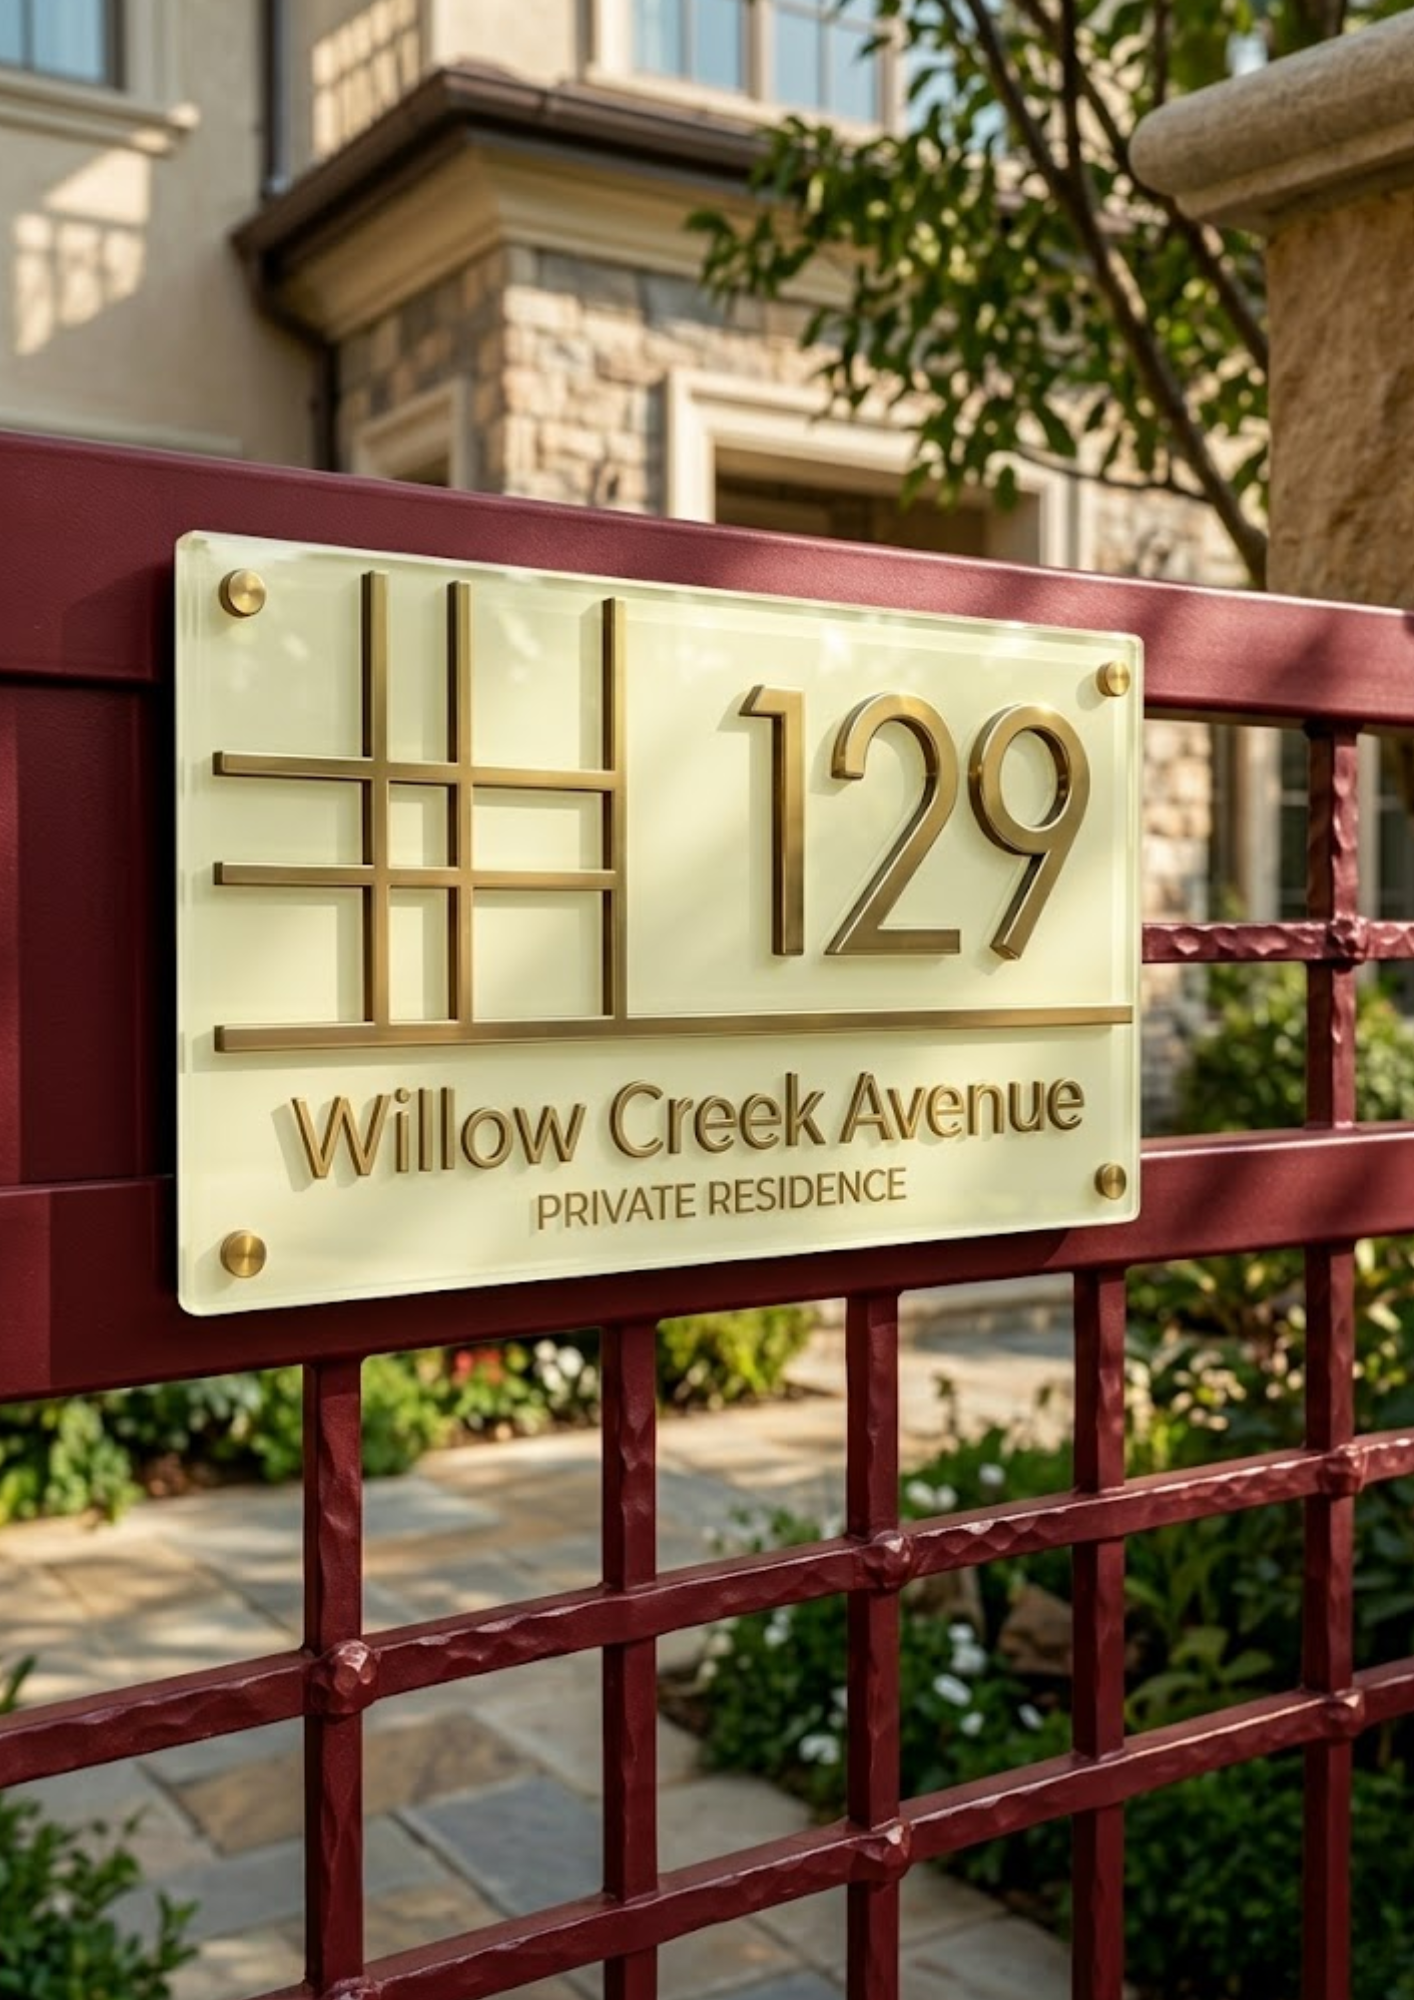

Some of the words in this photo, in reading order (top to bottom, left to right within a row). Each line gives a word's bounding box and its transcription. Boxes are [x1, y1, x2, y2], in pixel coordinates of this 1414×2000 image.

[738, 684, 1091, 961] 129
[290, 1086, 587, 1180] Willow
[608, 1071, 826, 1160] Creek
[838, 1071, 1086, 1145] Avenue
[536, 1182, 697, 1231] PRIVATE
[708, 1166, 908, 1216] RESIDENCE
